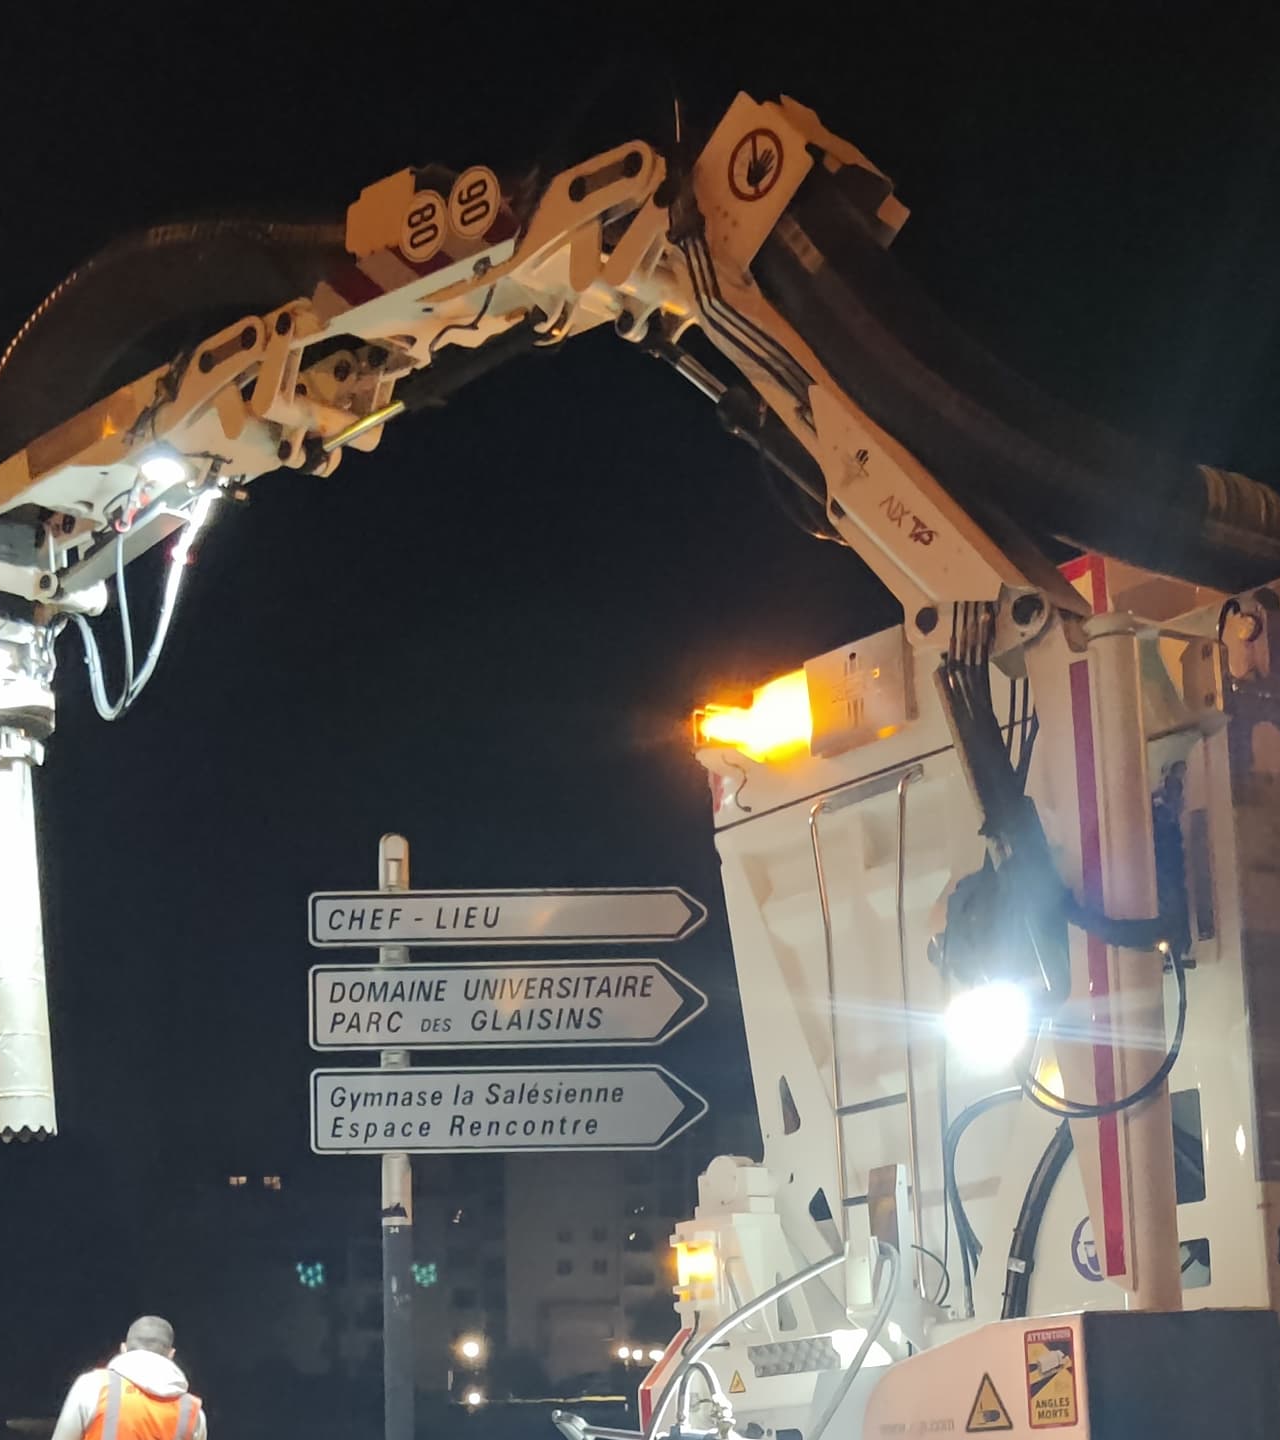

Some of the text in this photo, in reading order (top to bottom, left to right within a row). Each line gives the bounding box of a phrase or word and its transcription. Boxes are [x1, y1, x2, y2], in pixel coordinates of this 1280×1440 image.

[328, 908, 402, 930] CHEF
[435, 906, 500, 929] LIEU
[329, 975, 654, 1003] DOMAINE UNIVERSITAIRE
[329, 1006, 603, 1034] PARC DES GLAISINS
[330, 1081, 624, 1112] Gymnase la Salésienne
[331, 1115, 598, 1144] Espace Rencontre
[1036, 1397, 1070, 1409] ANGLES
[1037, 1408, 1070, 1420] MORTS
